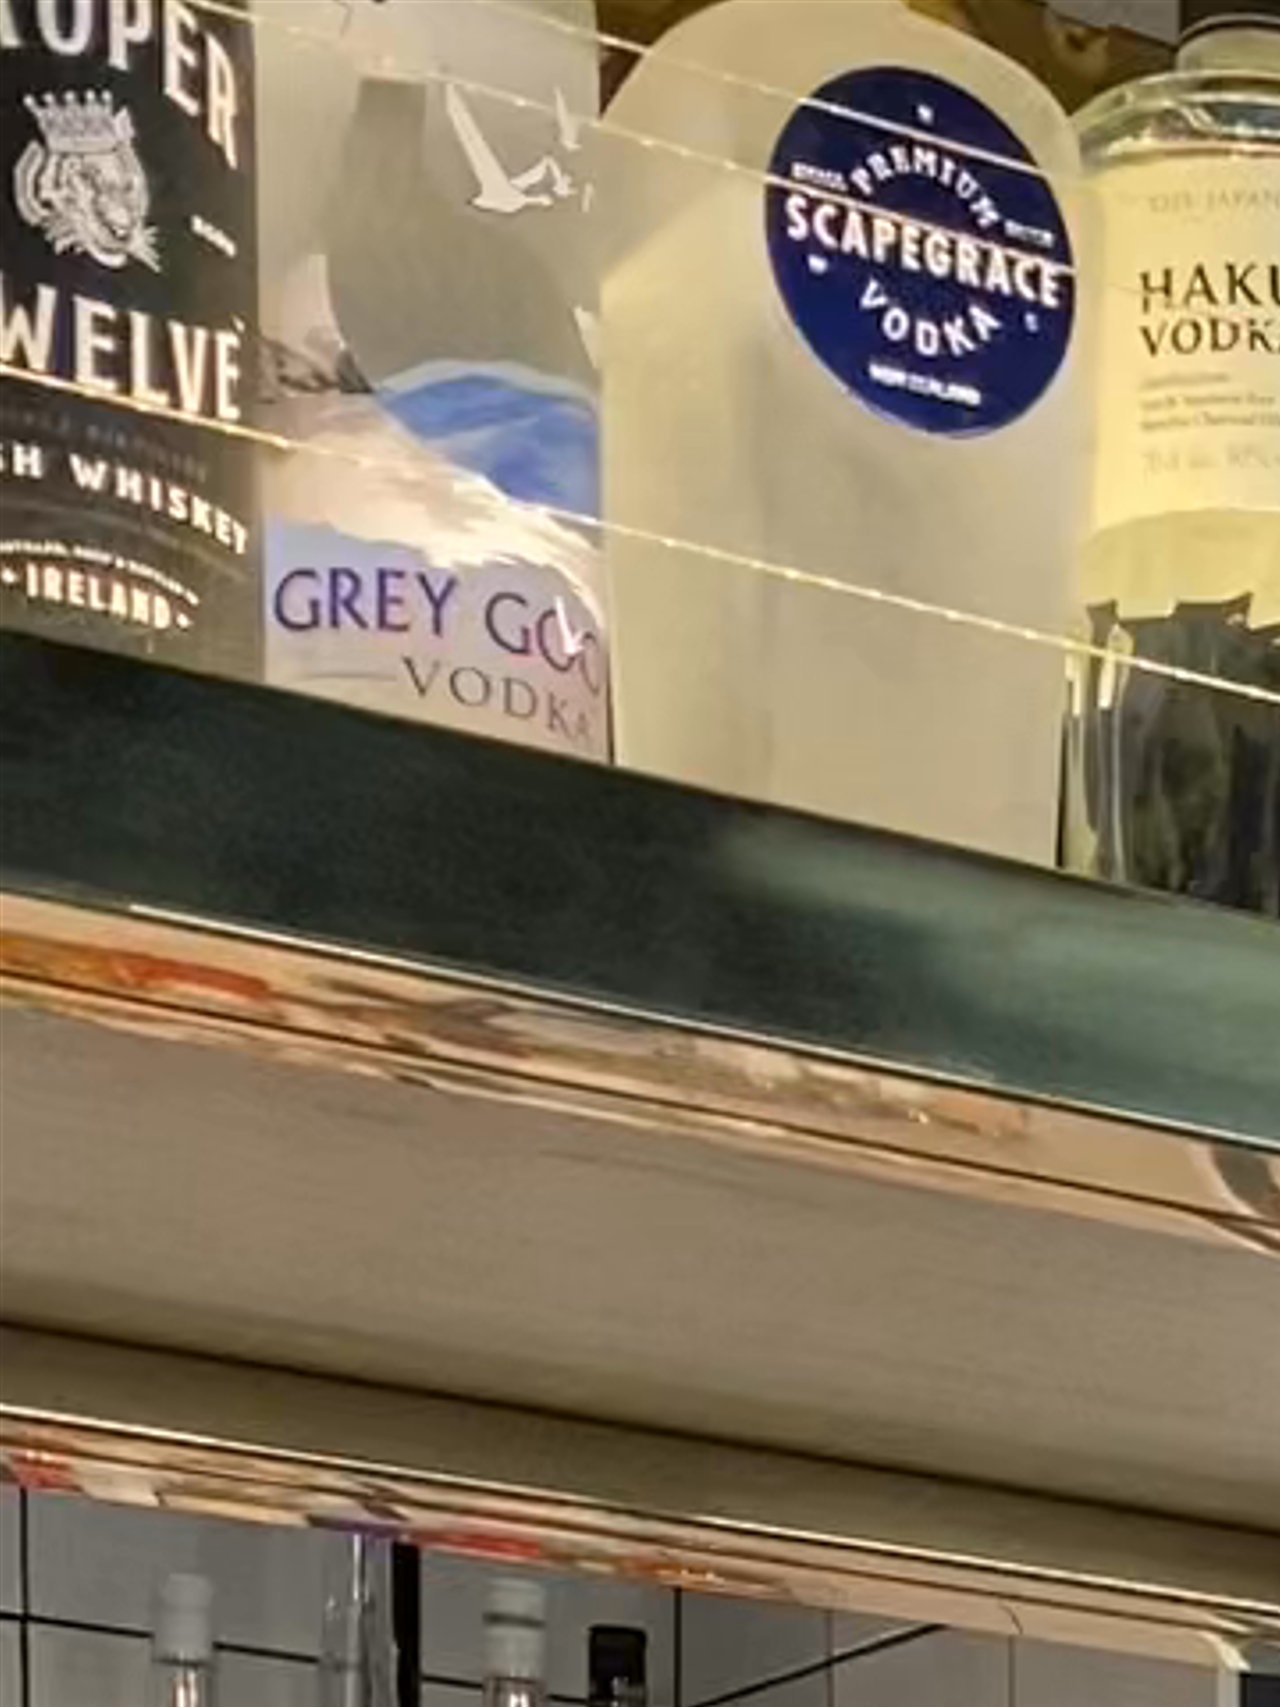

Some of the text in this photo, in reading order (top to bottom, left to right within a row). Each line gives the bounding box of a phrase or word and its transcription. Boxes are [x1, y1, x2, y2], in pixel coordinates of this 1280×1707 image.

[850, 144, 999, 228] PREMIUM
[785, 194, 1058, 308] SCAPEGRACE
[860, 278, 1002, 356] VODKA
[69, 452, 248, 554] WHISKEY
[26, 562, 171, 630] IRELAND
[273, 566, 455, 638] GREY
[400, 655, 590, 741] VODKA
